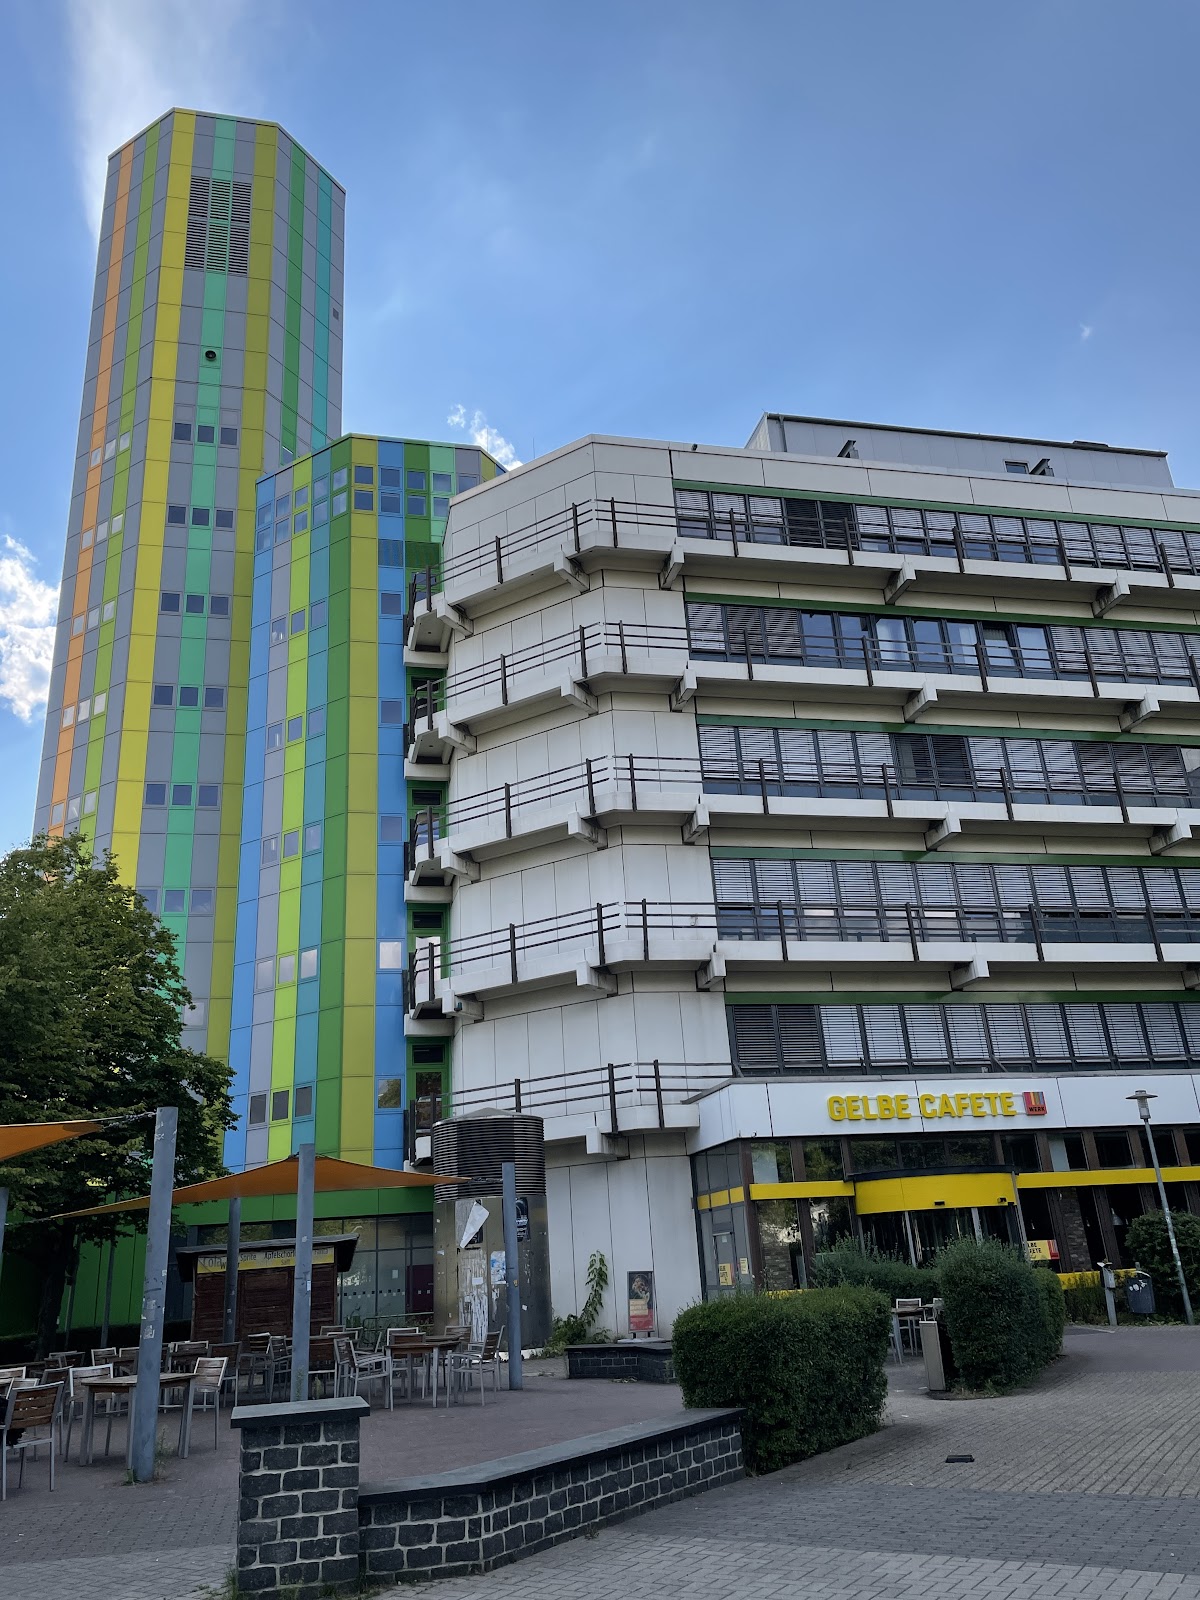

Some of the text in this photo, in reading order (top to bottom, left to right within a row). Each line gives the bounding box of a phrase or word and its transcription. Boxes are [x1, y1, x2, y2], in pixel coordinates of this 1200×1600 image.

[827, 1092, 1017, 1121] GELBE CAFETE
[264, 1249, 295, 1260] Apfelschorl
